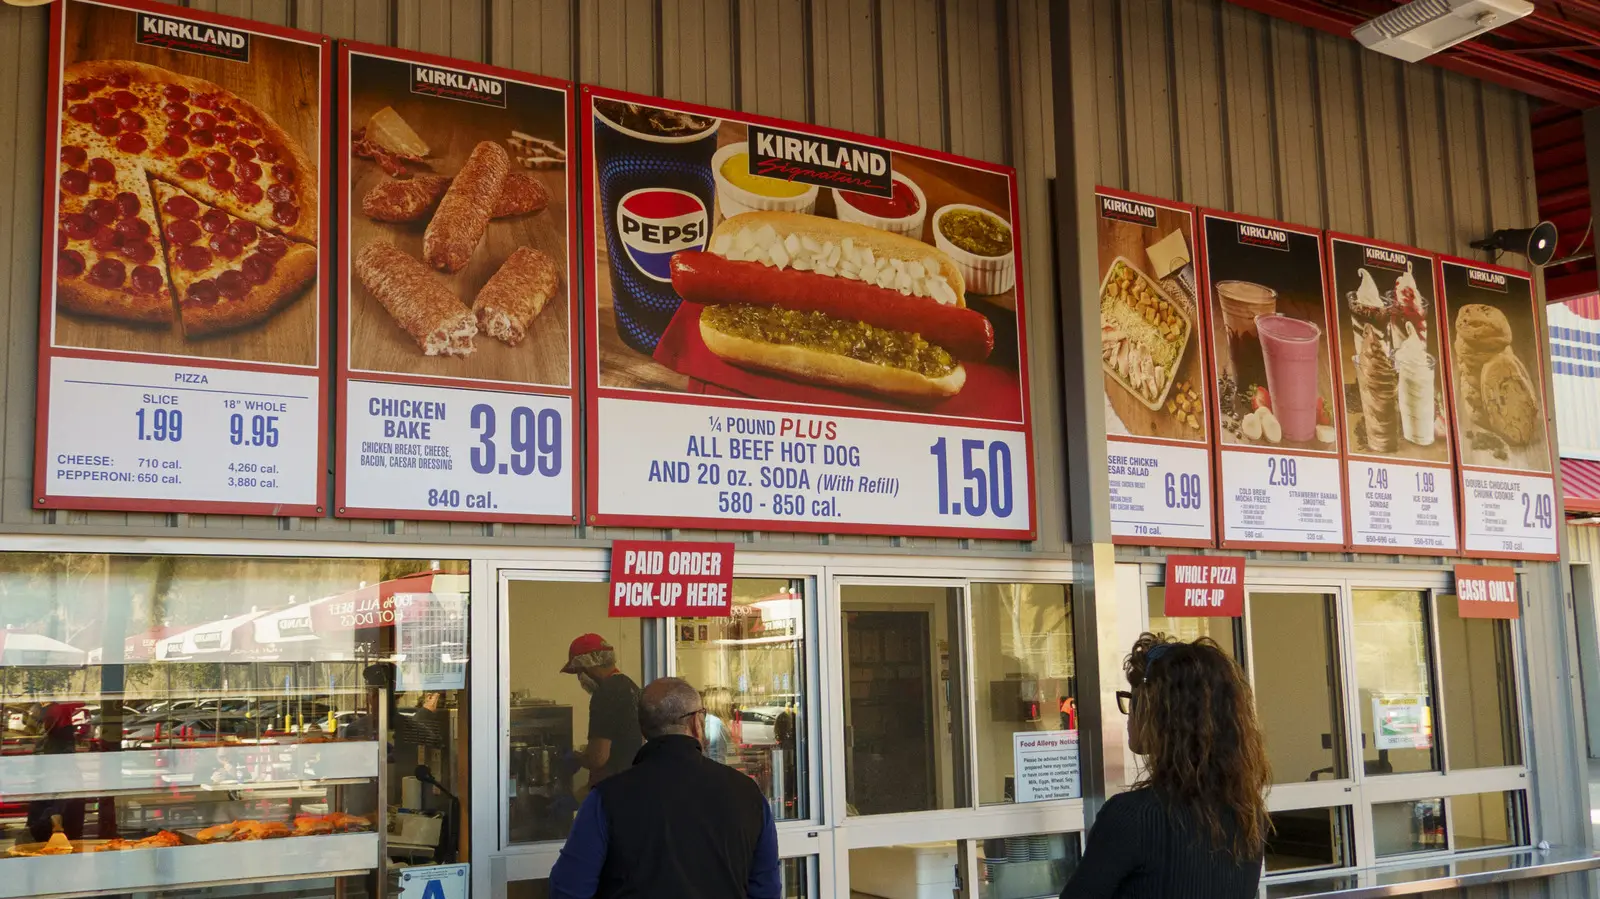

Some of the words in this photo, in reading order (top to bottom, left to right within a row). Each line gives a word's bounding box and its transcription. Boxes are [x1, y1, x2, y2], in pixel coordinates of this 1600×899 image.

[144, 17, 245, 48] KIRKLAND
[416, 68, 502, 94] KIRKLAND
[757, 132, 886, 176] KIRKLAND
[757, 157, 887, 189] Signature
[1104, 199, 1154, 218] KIRKLAND
[622, 214, 704, 244] PEPSI
[1240, 225, 1286, 242] KIRKLAND
[1366, 248, 1406, 264] KIRKLAND
[1469, 270, 1505, 285] KIRKLAND
[174, 373, 209, 384] PIZZA
[143, 394, 179, 405] SLICE
[245, 401, 287, 412] WHOLE
[369, 397, 446, 420] CHICKEN
[136, 408, 182, 442] 1.99
[230, 413, 278, 447] 9.95
[384, 420, 431, 440] BAKE
[727, 417, 775, 435] POUND
[780, 418, 837, 440] PLUS
[362, 442, 392, 454] CHICKEN
[394, 444, 422, 458] BREAST,
[424, 445, 451, 458] CHEESE,
[470, 404, 562, 477] 3.99
[687, 435, 722, 458] ALL
[730, 438, 774, 460] BEEF
[781, 442, 817, 464] HOT
[824, 445, 860, 467] DOG
[57, 455, 114, 466] CHEESE:
[138, 458, 158, 469] 710
[162, 458, 182, 470] cal.
[228, 463, 257, 474] 4,260
[260, 463, 279, 474] cal.
[361, 455, 387, 468] BACON,
[390, 456, 416, 469] CAESAR
[419, 457, 452, 470] DRESSING
[1127, 467, 1149, 476] SALAD
[1130, 457, 1158, 467] CHICKEN
[1268, 457, 1297, 486] 2.99
[57, 470, 135, 482] PEPPERONI:
[137, 473, 158, 484] 650
[162, 473, 181, 484] cal.
[228, 477, 257, 488] 3,880
[260, 478, 279, 488] cal.
[648, 460, 690, 483] AND
[698, 463, 720, 485] 20
[727, 470, 752, 486] oz.
[760, 466, 810, 489] SODA
[817, 474, 854, 494] (With
[859, 476, 899, 498] Refill)
[930, 436, 1013, 518] 1.50
[1368, 468, 1388, 489] 2.49
[1415, 472, 1434, 492] 1.99
[1466, 479, 1488, 489] DOUBLE
[1489, 481, 1520, 491] CHOCOLATE
[428, 489, 459, 507] 840
[466, 491, 498, 509] cal.
[1165, 472, 1201, 509] 6.99
[1289, 491, 1319, 499] STRAWBERRY
[1474, 490, 1493, 499] CHUNK
[1494, 492, 1515, 500] COOKIE
[719, 491, 752, 513] 580
[773, 494, 805, 516] 850
[812, 496, 841, 517] cal.
[1522, 493, 1552, 529] 2.49
[1134, 526, 1147, 534] 710
[1149, 526, 1161, 535] cal.
[1514, 542, 1524, 550] cal.
[624, 550, 664, 574] PAID
[668, 551, 722, 576] ORDER
[1175, 565, 1208, 584] WHOLE
[1210, 566, 1237, 584] PIZZA
[614, 582, 682, 606] PICK-UP
[686, 583, 728, 606] HERE
[1184, 588, 1224, 607] PICK-UP
[1458, 579, 1487, 601] CASH
[1489, 580, 1515, 602] ONLY
